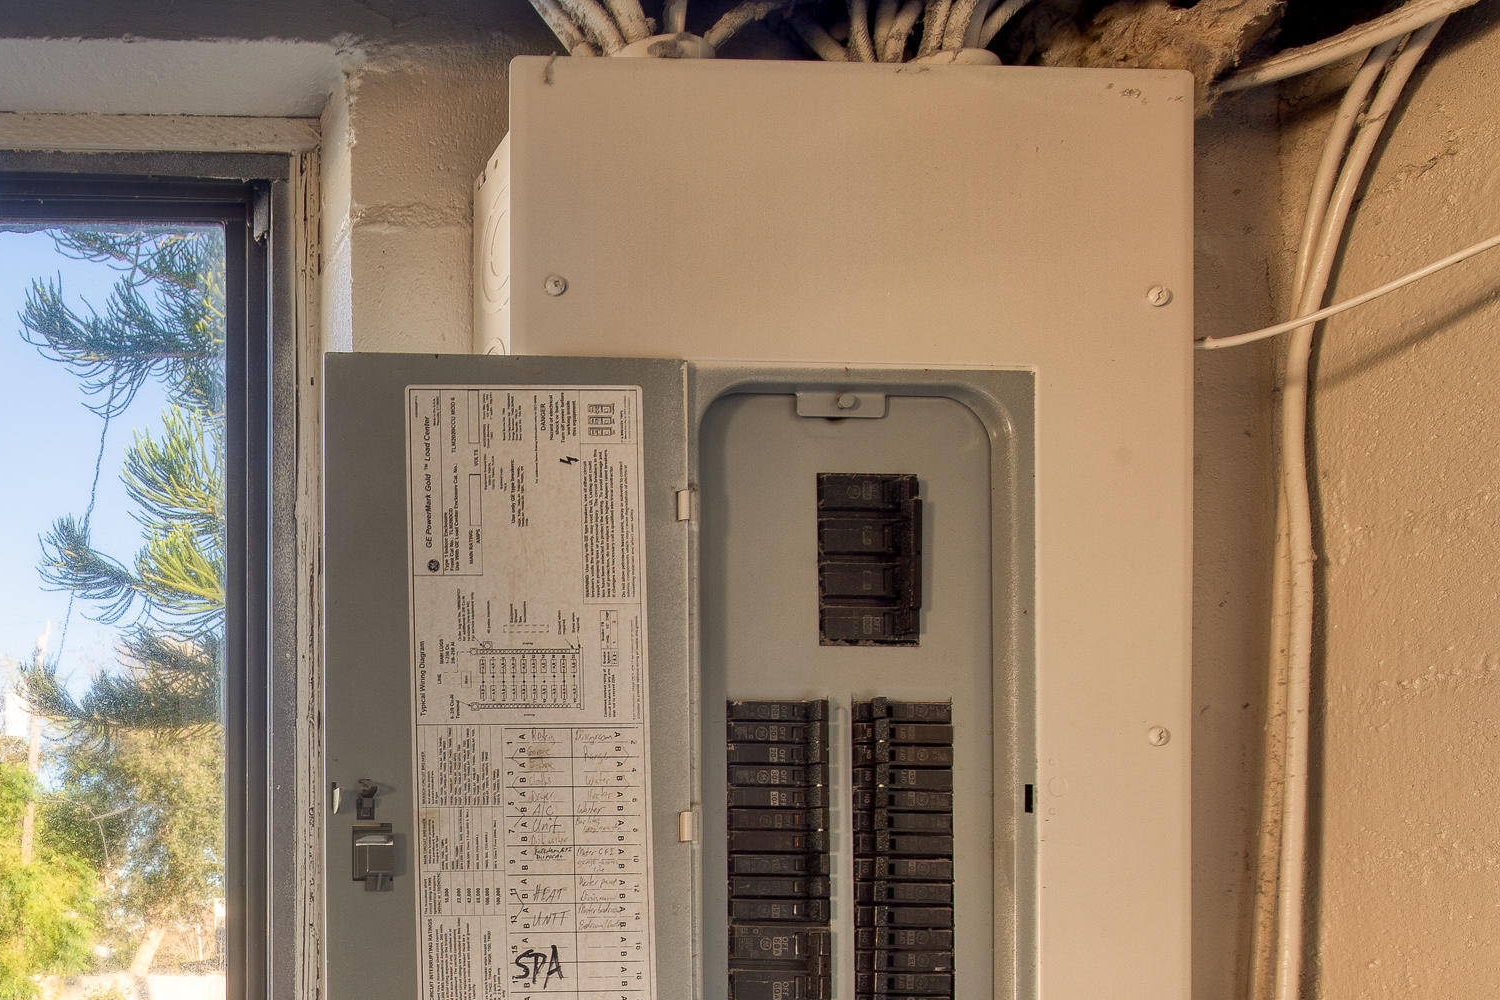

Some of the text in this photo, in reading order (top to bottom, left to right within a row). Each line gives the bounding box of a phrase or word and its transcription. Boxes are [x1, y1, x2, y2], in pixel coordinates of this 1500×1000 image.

[426, 536, 432, 548] GE
[533, 884, 568, 901] HEAT
[512, 945, 518, 954] 15
[514, 944, 564, 990] SPA
[636, 972, 642, 980] 18
